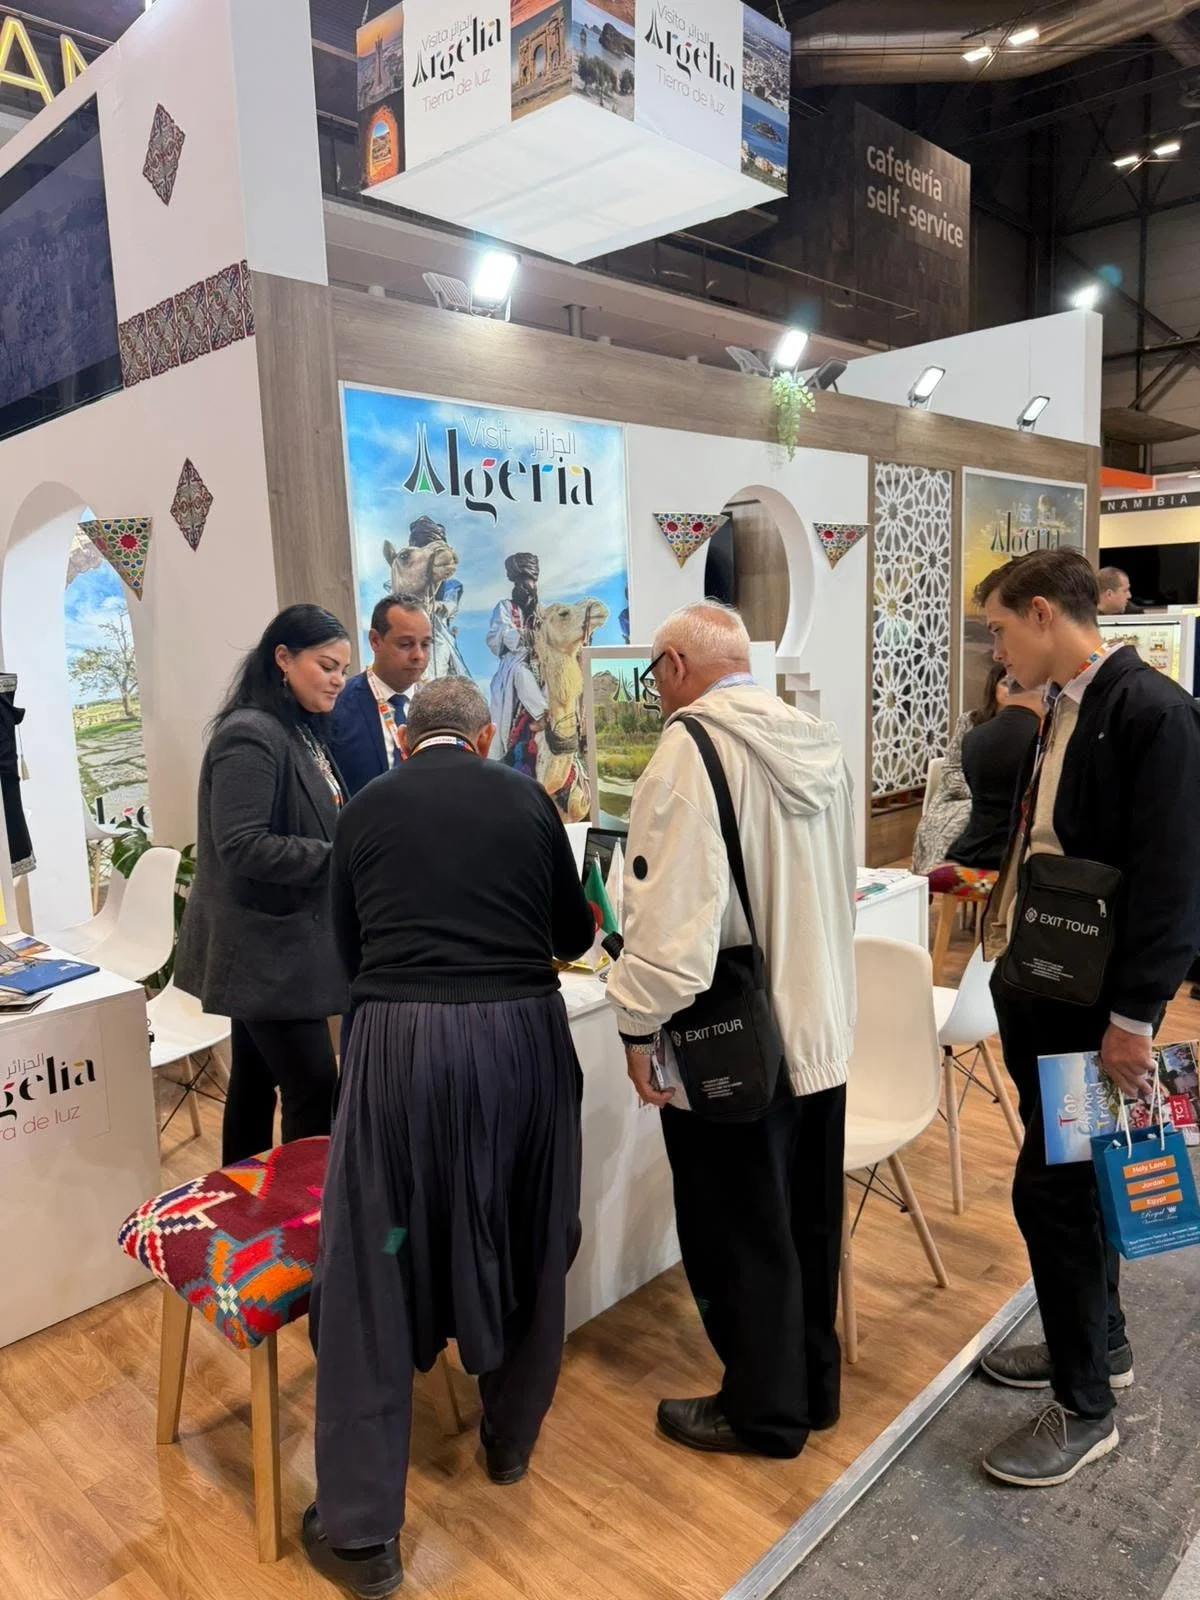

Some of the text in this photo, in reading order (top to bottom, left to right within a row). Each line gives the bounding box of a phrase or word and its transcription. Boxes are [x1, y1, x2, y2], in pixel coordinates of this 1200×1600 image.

[657, 0, 687, 31] Visita
[412, 16, 501, 88] Argelia
[421, 28, 449, 52] Visita
[644, 7, 735, 91] Argelia
[422, 67, 492, 113] Tierra de luz
[656, 63, 726, 117] Tierra de luz
[866, 145, 943, 203] cafetería
[866, 184, 965, 249] self-service
[462, 415, 513, 451] Visit
[401, 421, 595, 528] Algeria
[1107, 494, 1189, 511] NAMIBIA
[1039, 913, 1100, 937] EXIT TOUR
[685, 1019, 744, 1042] EXIT TOUR
[22, 1115, 50, 1134] de
[54, 1105, 81, 1124] luz
[1059, 1093, 1079, 1129] Top
[1173, 1099, 1185, 1121] TCT
[1149, 1160, 1168, 1170] Land
